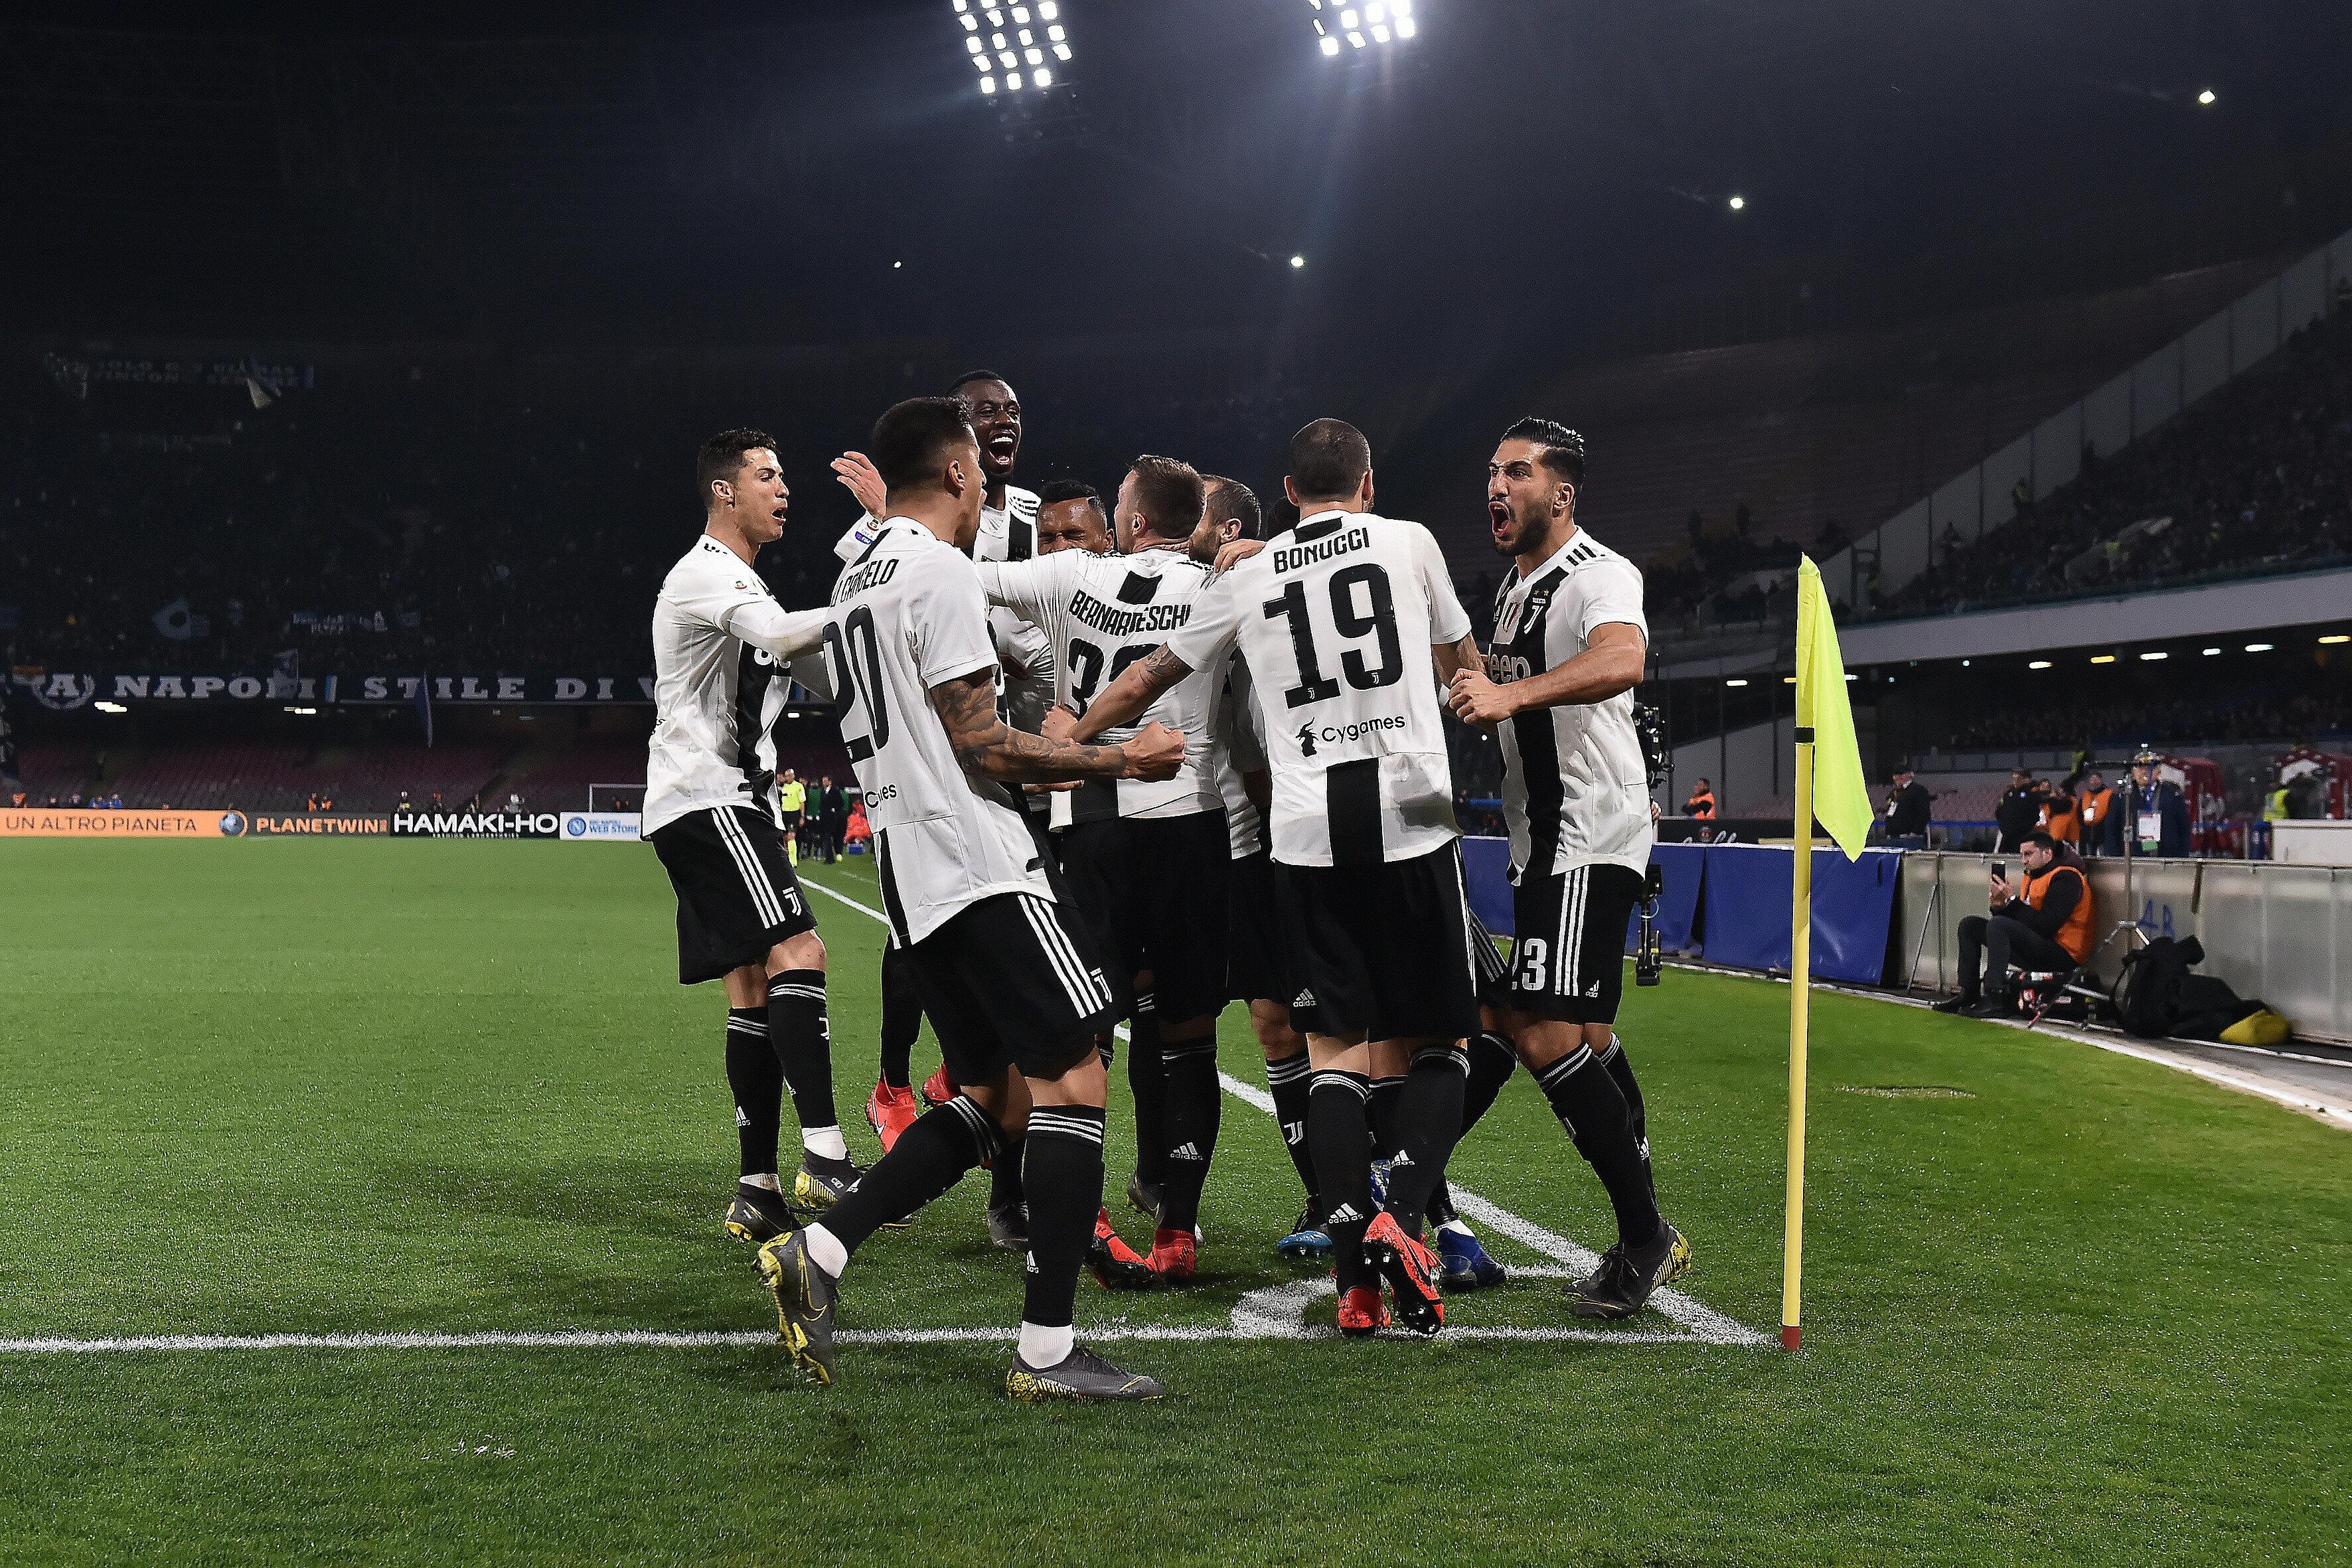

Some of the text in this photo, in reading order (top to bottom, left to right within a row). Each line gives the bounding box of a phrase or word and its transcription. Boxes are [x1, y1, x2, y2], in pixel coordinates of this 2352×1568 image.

[1273, 527, 1370, 574] BONUCCI
[1262, 563, 1404, 710] 19
[1487, 653, 1531, 684] eep
[555, 677, 615, 700] DI
[1321, 716, 1406, 744] Cygames
[6, 816, 197, 831] UN ALTRO PIANETA
[394, 813, 558, 833] HAMAKI-HO
